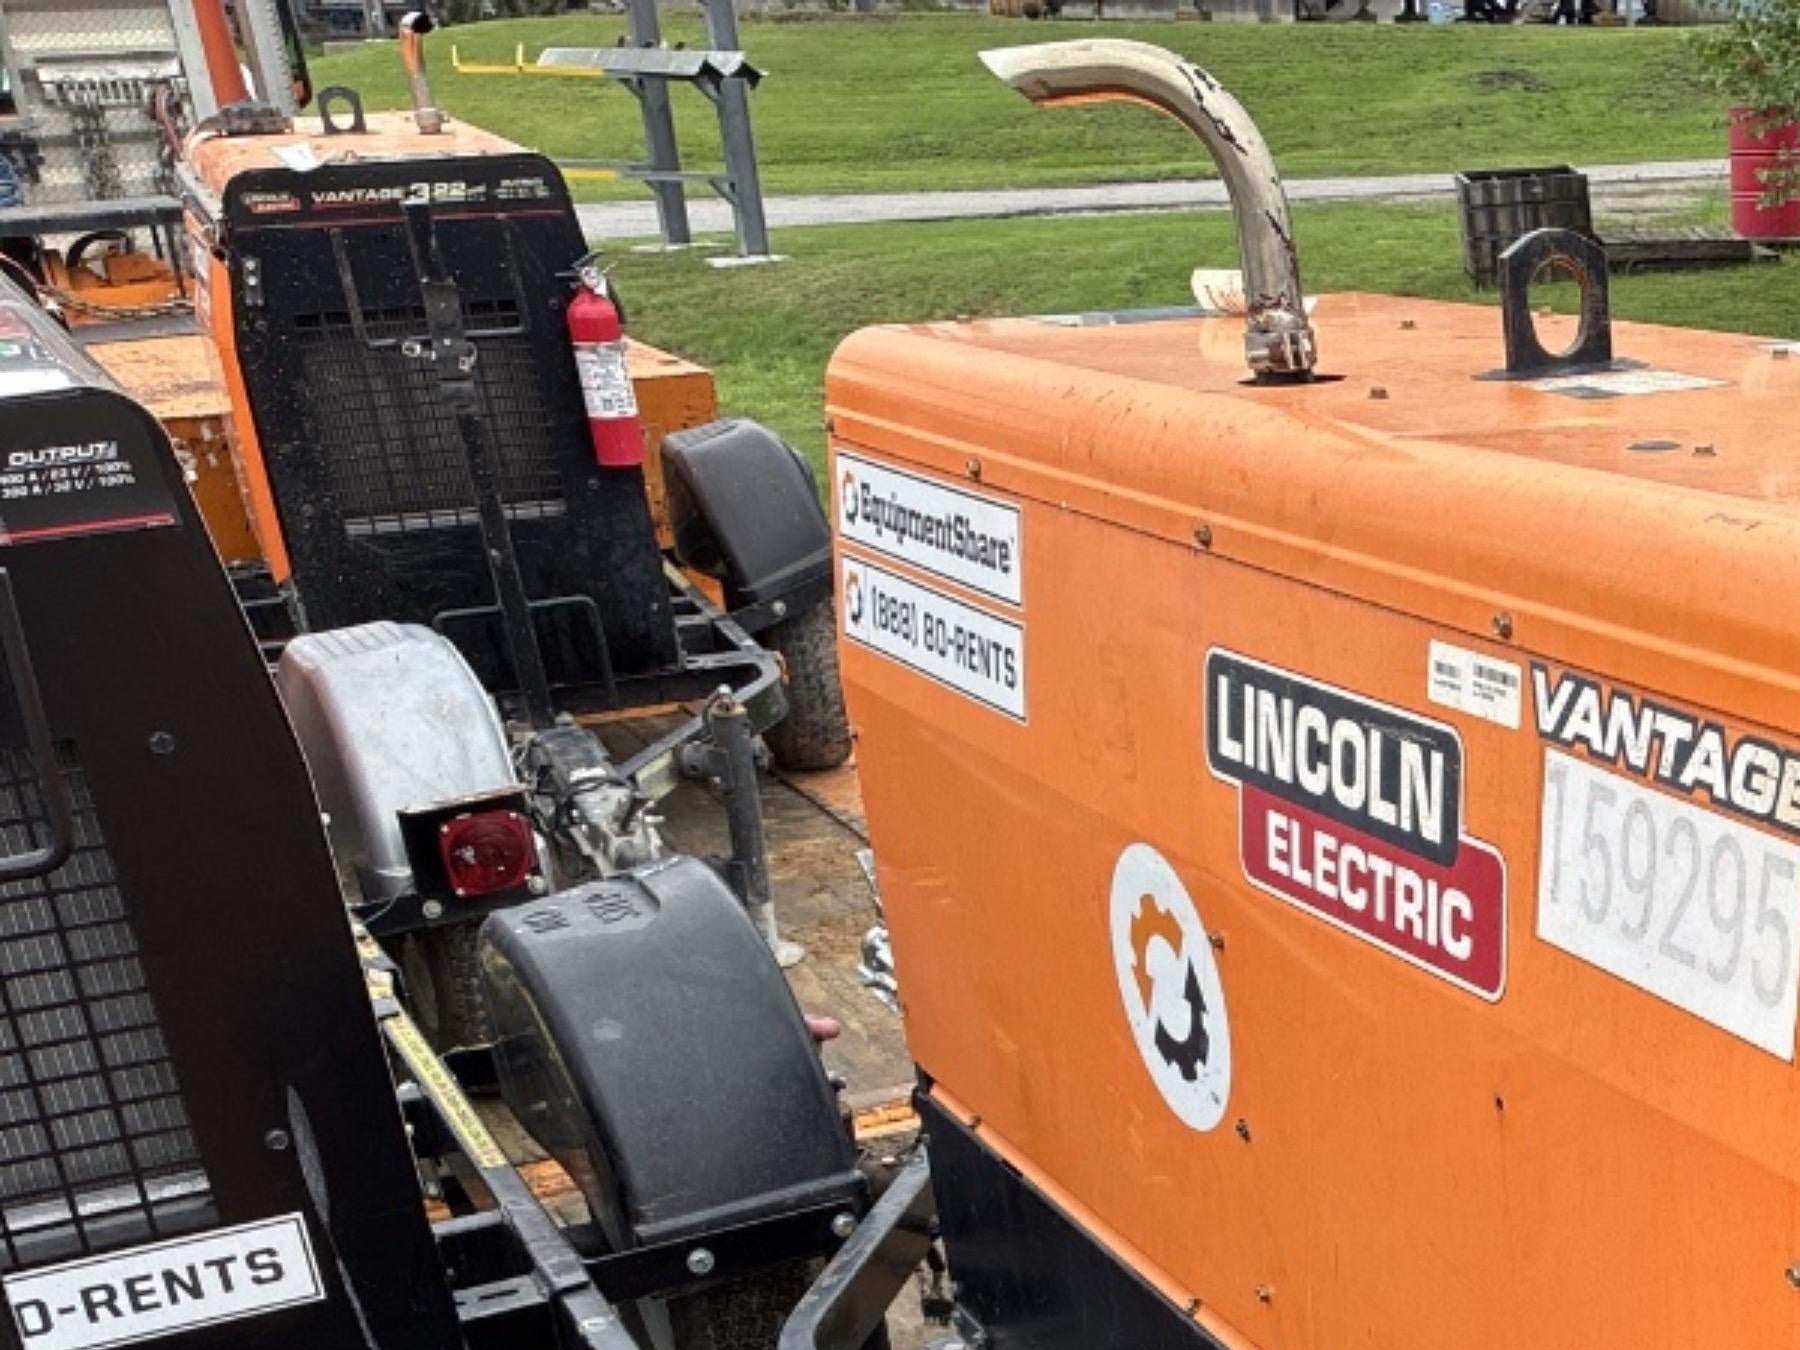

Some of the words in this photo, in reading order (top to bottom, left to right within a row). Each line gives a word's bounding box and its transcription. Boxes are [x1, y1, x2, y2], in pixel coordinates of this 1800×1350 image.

[311, 187, 402, 204] VANTAGE
[9, 441, 109, 467] OUTPUT
[861, 482, 1013, 575] EquipmentShare
[922, 611, 1017, 691] 80-RENTS
[1216, 673, 1445, 845] LINCOLN
[1265, 808, 1474, 961] ELECTRIC
[1548, 760, 1796, 1010] 159295
